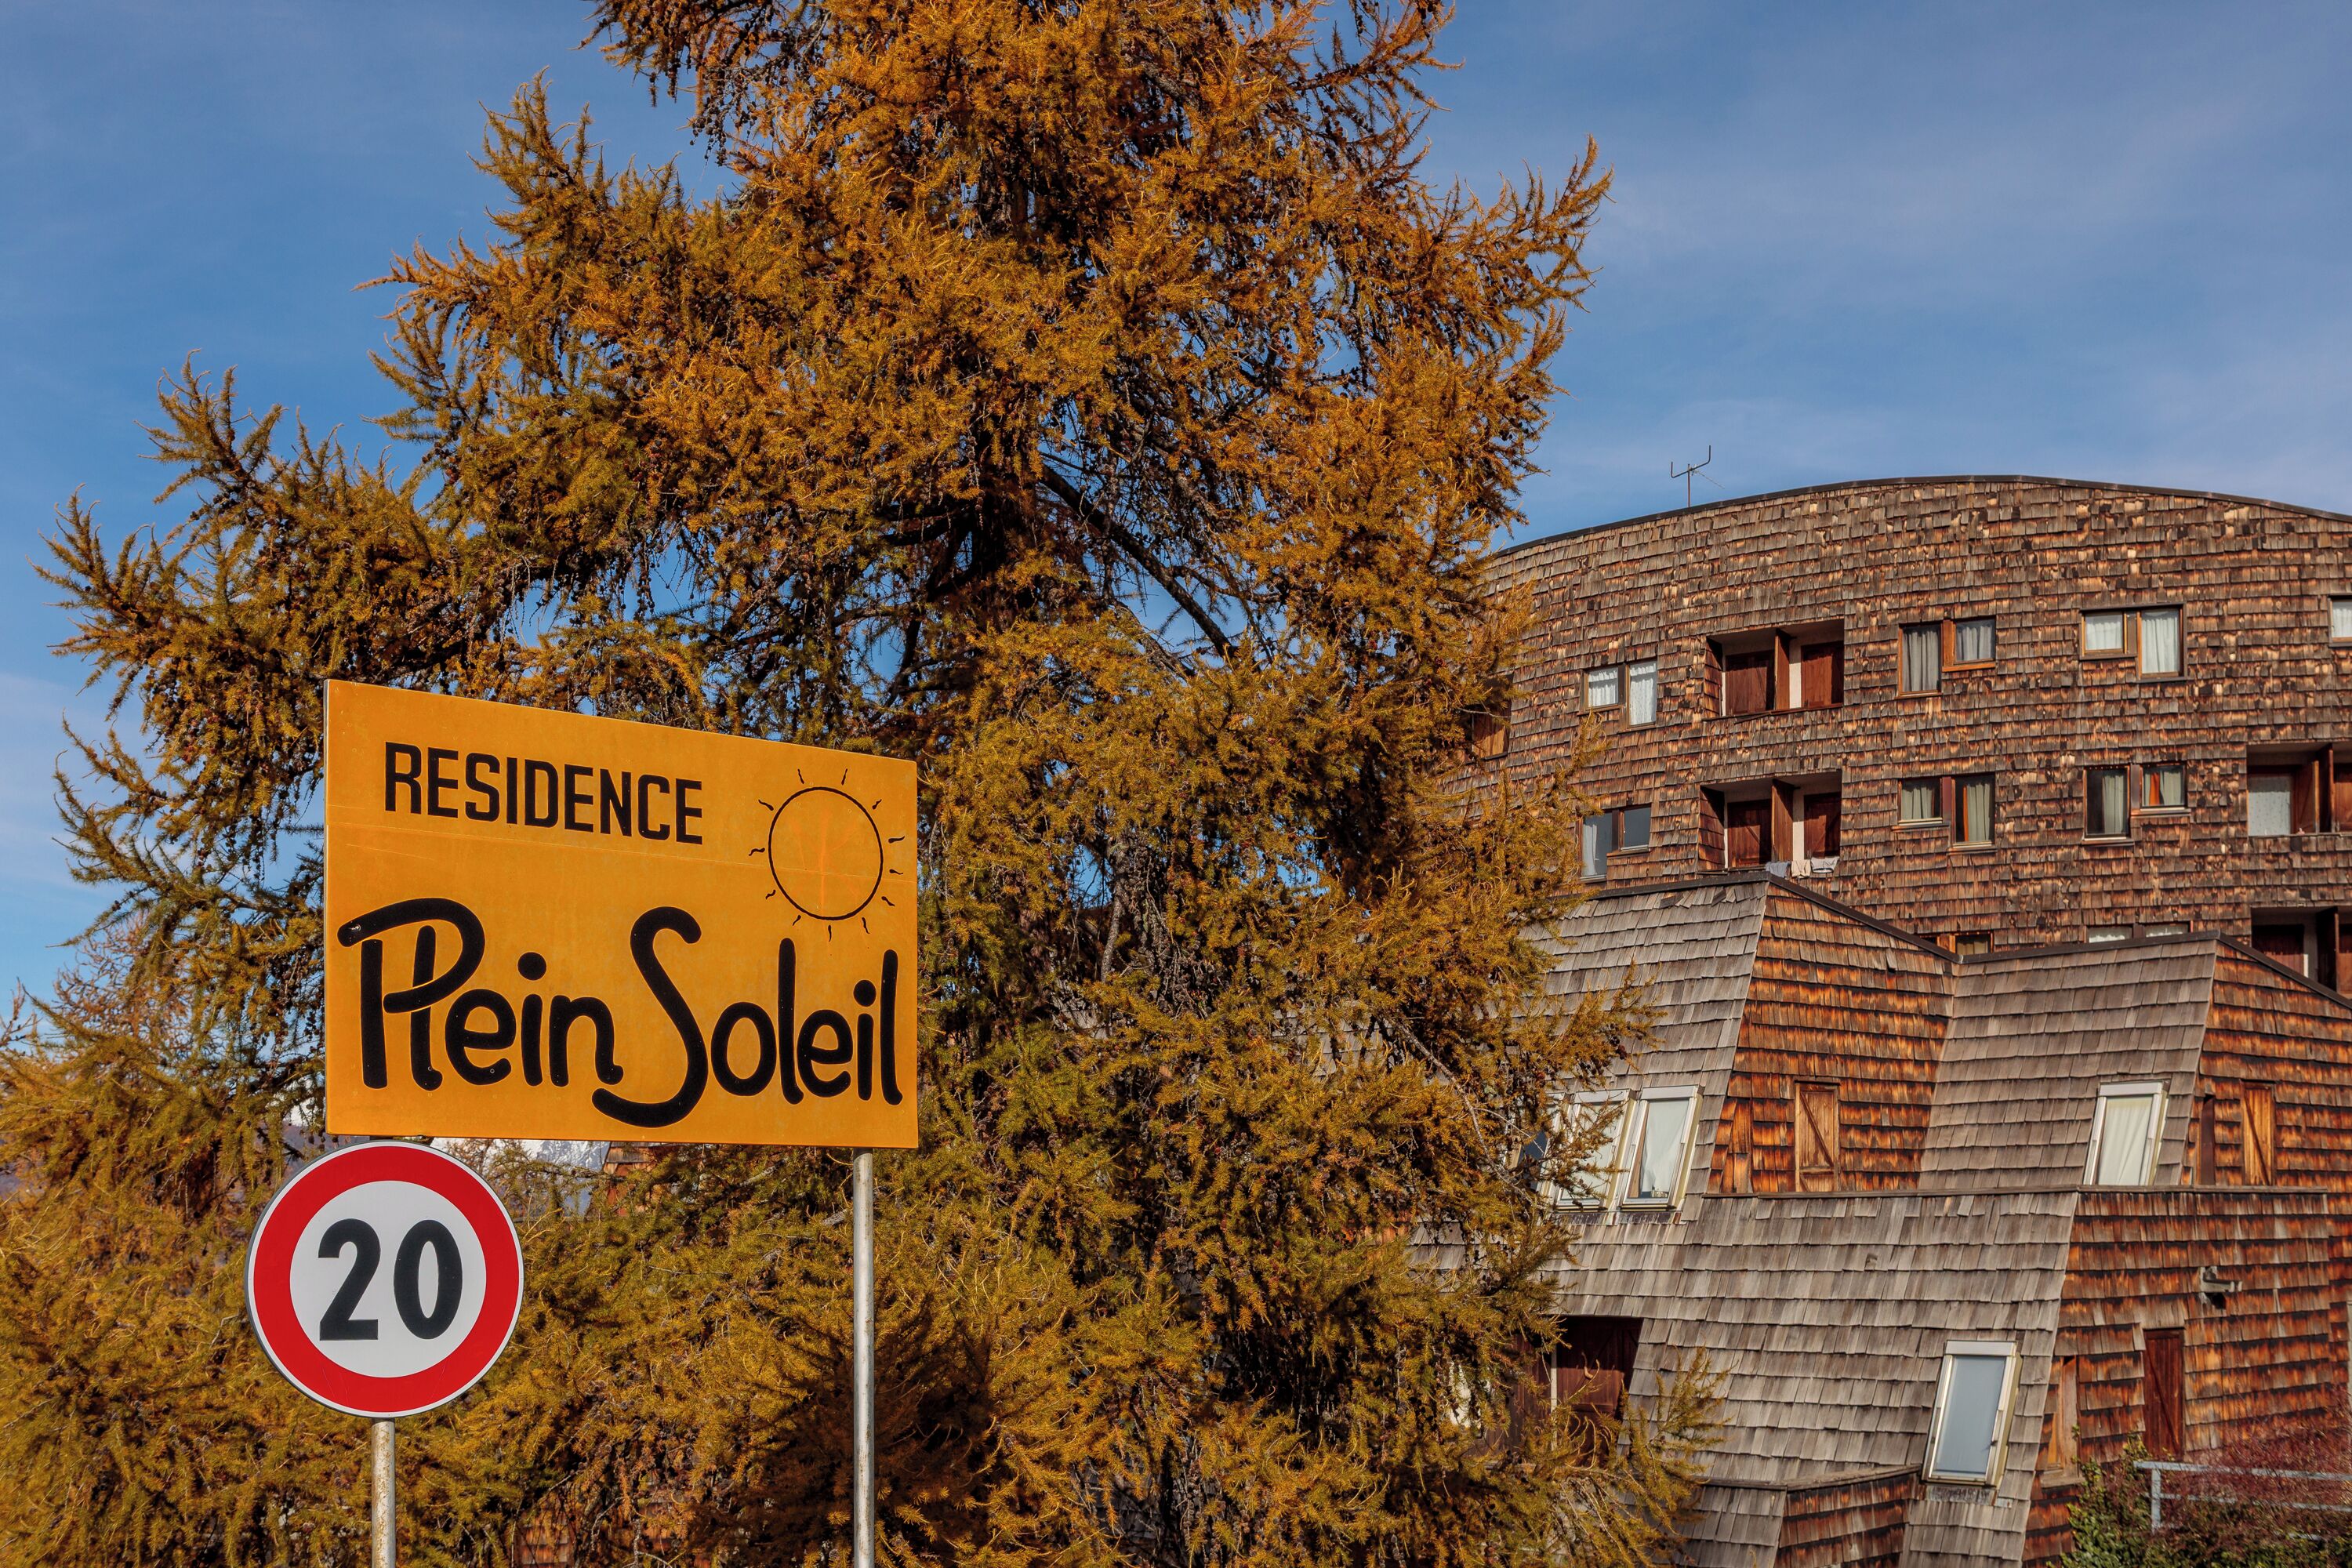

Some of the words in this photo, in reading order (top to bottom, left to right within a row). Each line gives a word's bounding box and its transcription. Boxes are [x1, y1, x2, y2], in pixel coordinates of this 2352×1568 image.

[385, 742, 703, 845] RESIDENCE
[337, 898, 625, 1092] Plein
[592, 906, 904, 1128] Soleil
[318, 1218, 463, 1341] 20
